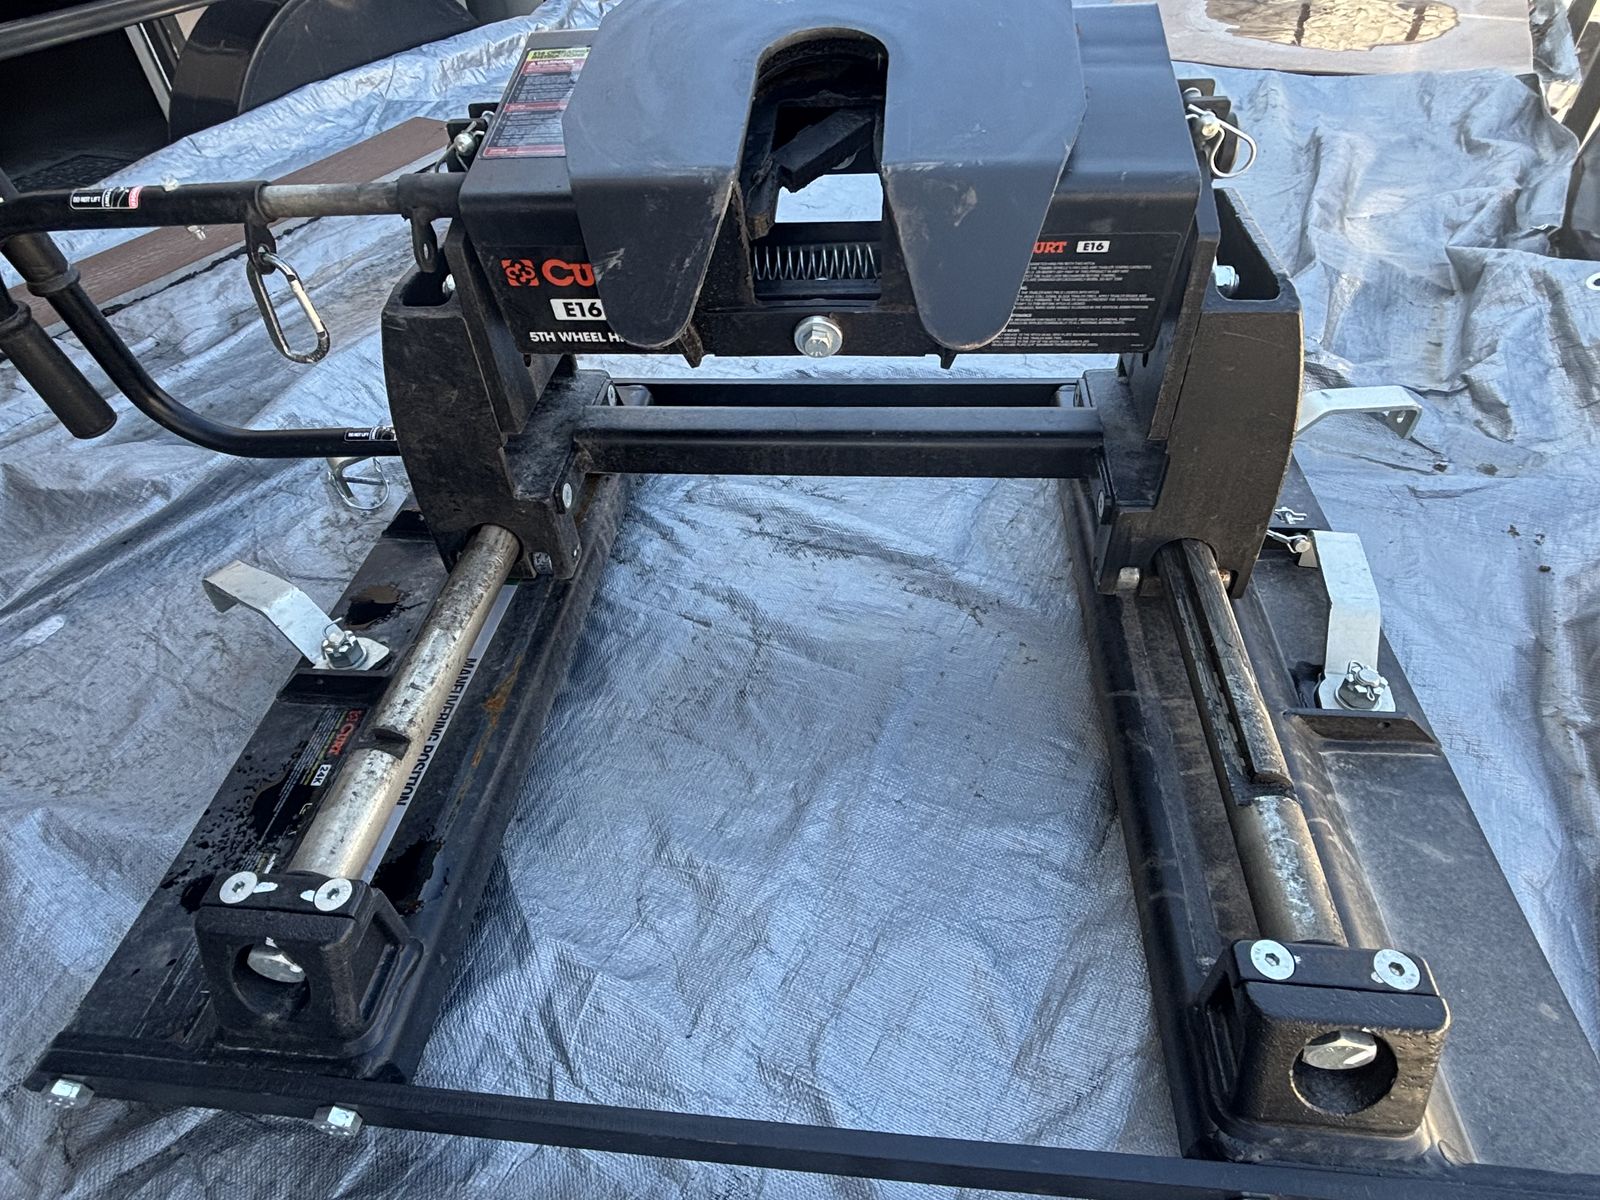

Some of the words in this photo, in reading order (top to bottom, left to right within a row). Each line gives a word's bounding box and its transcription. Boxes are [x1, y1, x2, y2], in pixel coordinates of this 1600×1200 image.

[1033, 241, 1067, 254] URT
[1083, 242, 1104, 251] E16
[541, 259, 595, 287] CU
[562, 302, 602, 318] E16
[529, 332, 556, 342] 5TH
[557, 332, 606, 342] WHEEL
[312, 766, 329, 784] 24K
